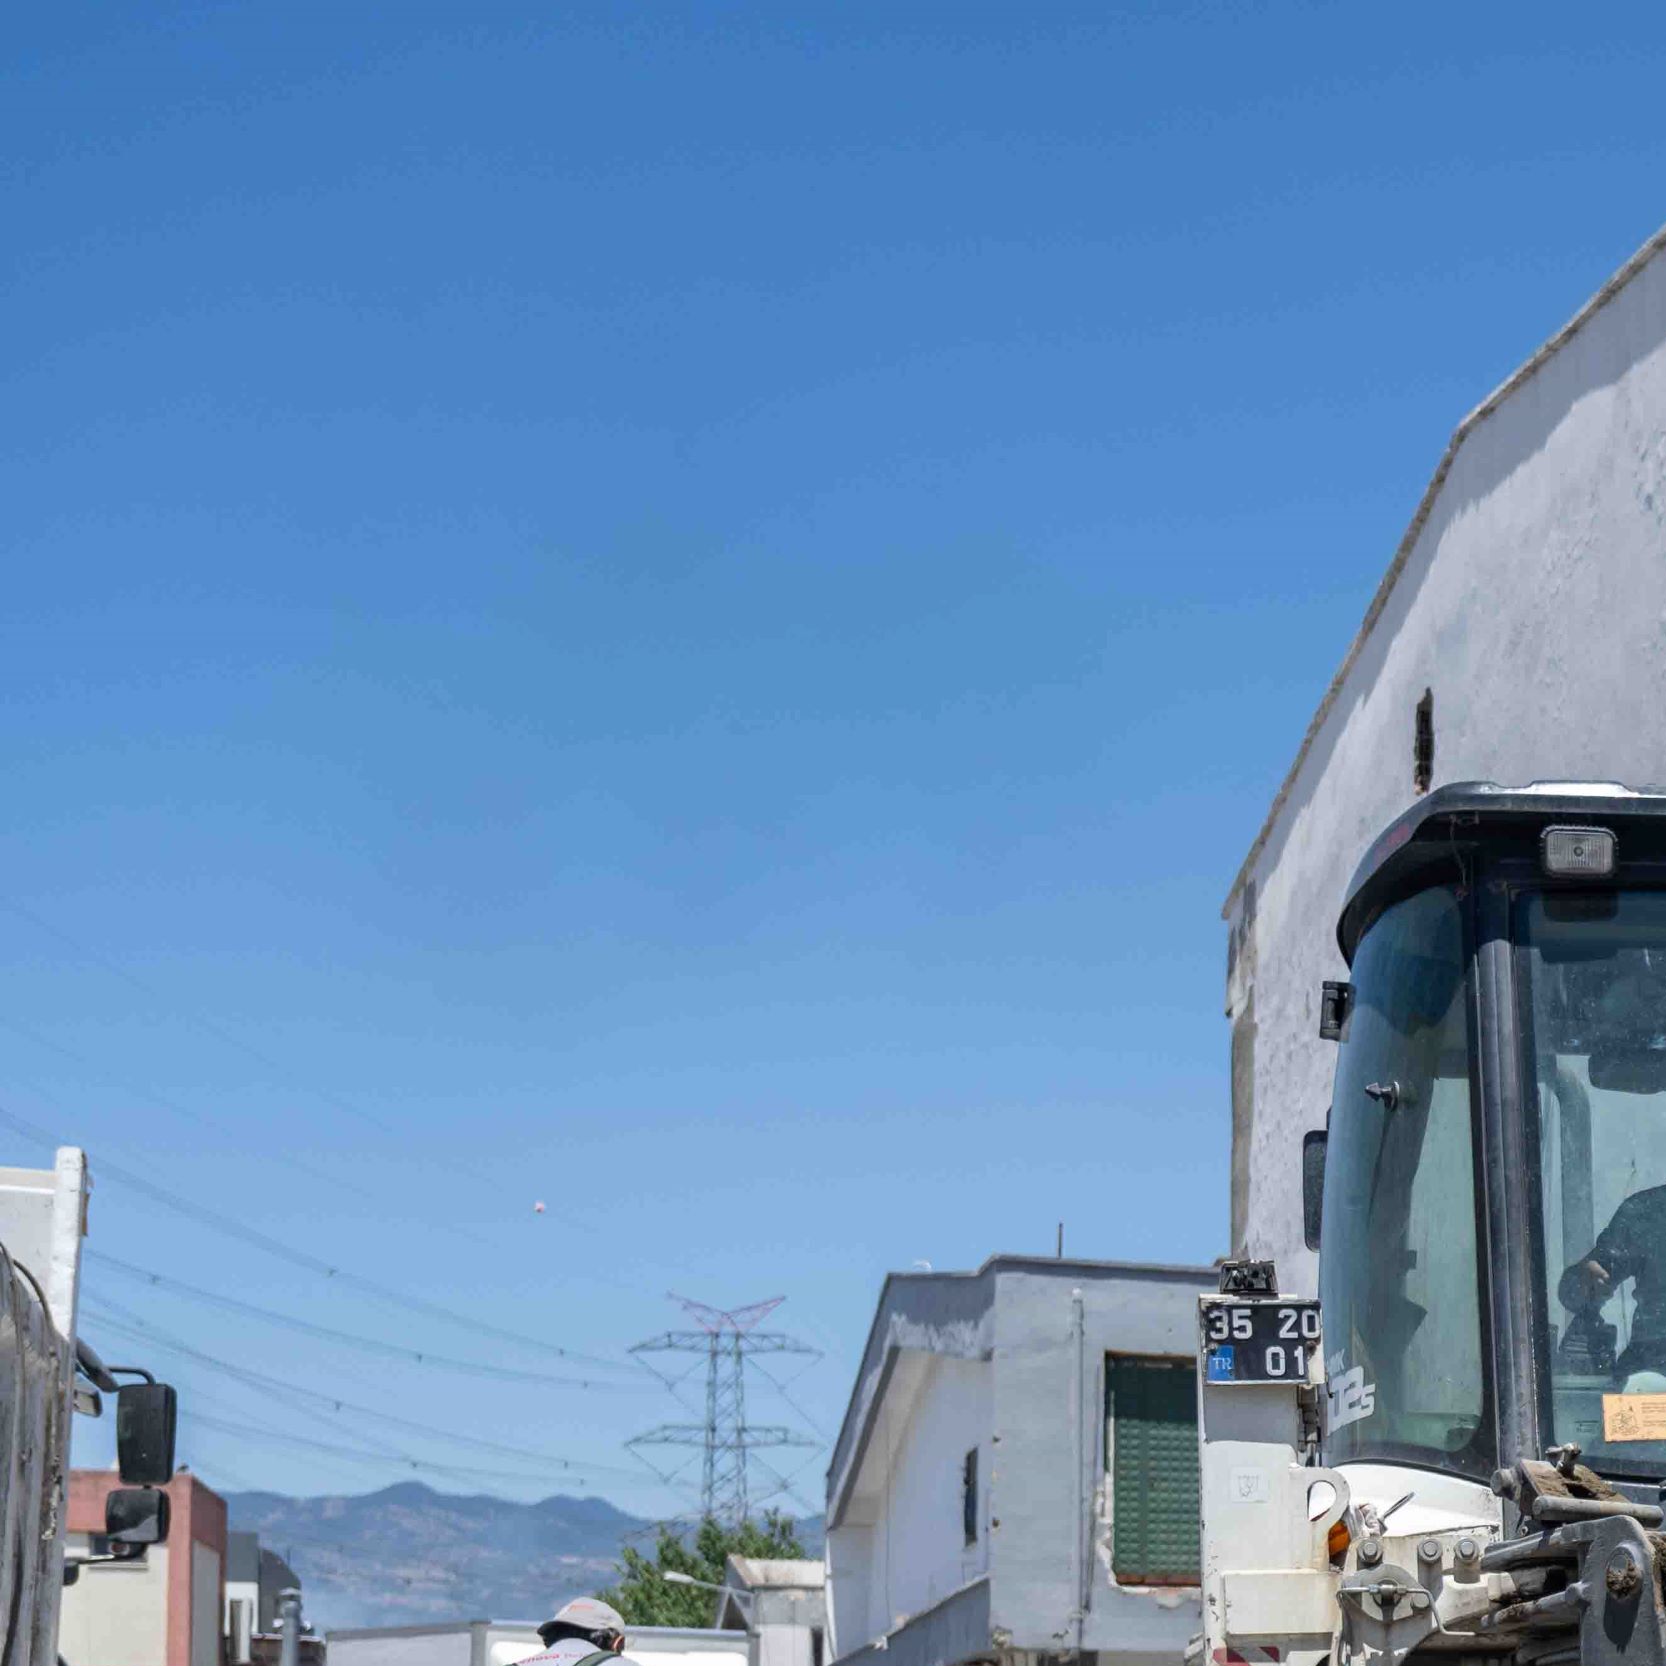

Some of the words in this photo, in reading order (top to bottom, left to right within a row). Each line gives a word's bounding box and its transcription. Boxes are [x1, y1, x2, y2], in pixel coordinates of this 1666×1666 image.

[1209, 1308, 1253, 1340] 35
[1278, 1308, 1320, 1339] 20
[1212, 1357, 1233, 1370] TR
[1265, 1345, 1304, 1376] 01
